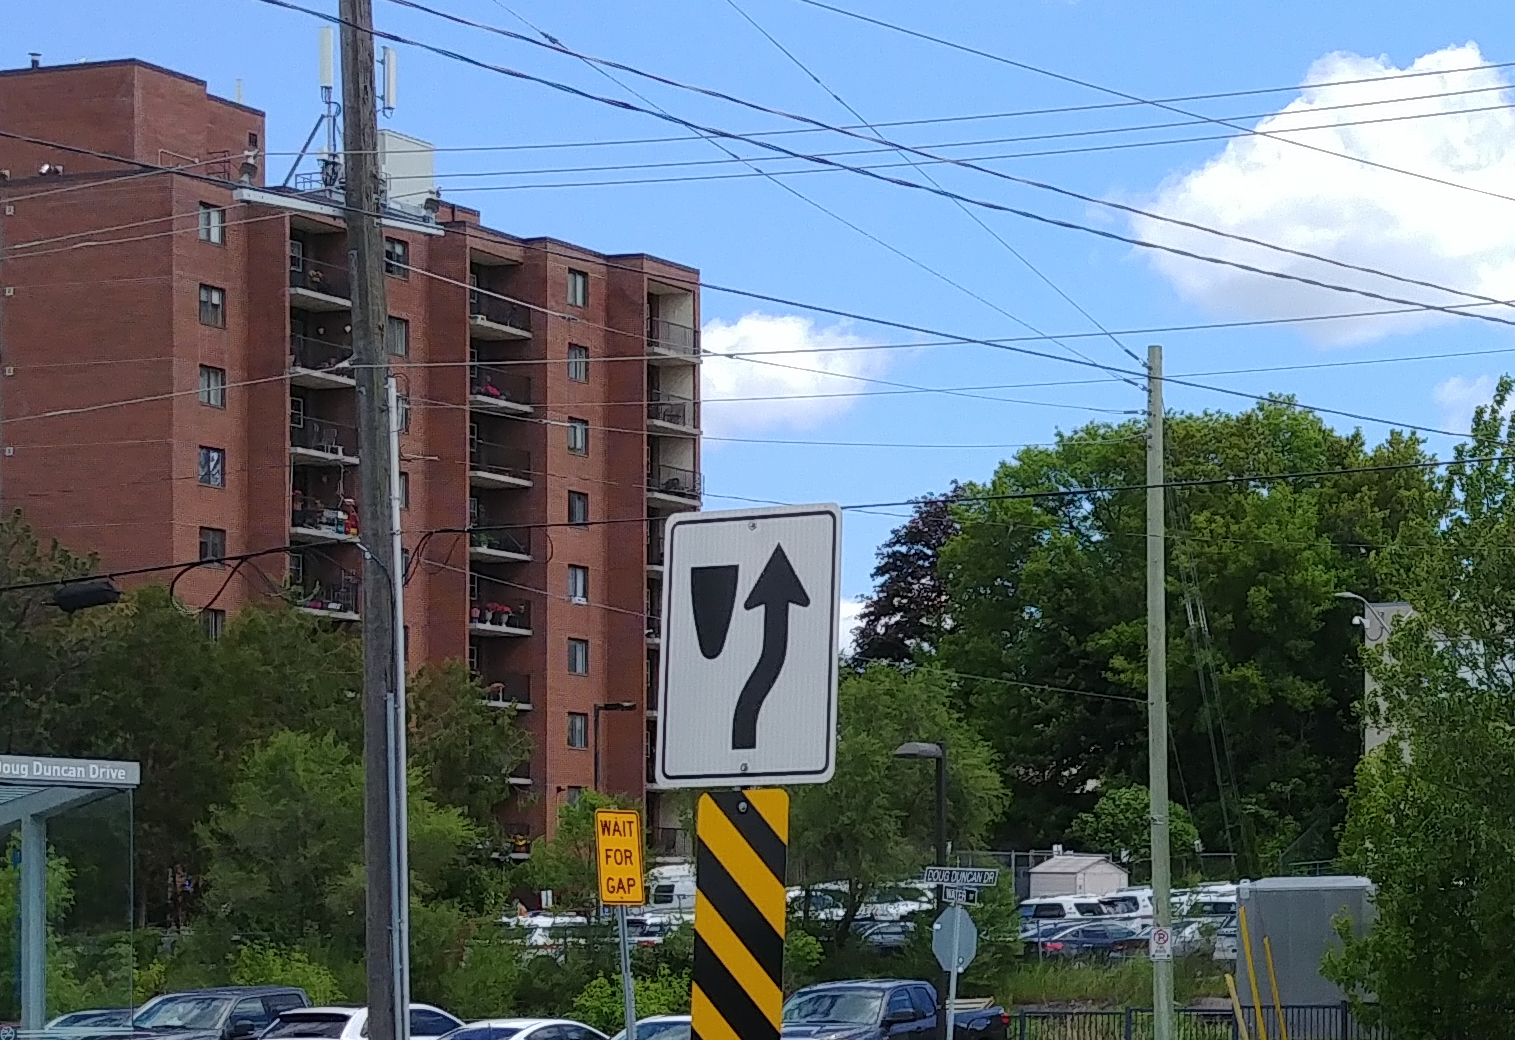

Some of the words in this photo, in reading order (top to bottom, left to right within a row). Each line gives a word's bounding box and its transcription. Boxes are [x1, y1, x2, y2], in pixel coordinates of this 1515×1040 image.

[33, 761, 86, 778] Duncan
[89, 764, 126, 780] Drive
[600, 819, 634, 837] WAIT
[605, 848, 634, 866] FOR
[927, 869, 950, 882] DOUG
[950, 870, 983, 883] DUNCAN
[983, 871, 995, 884] DR
[606, 877, 636, 894] GAP
[946, 888, 967, 901] WATER
